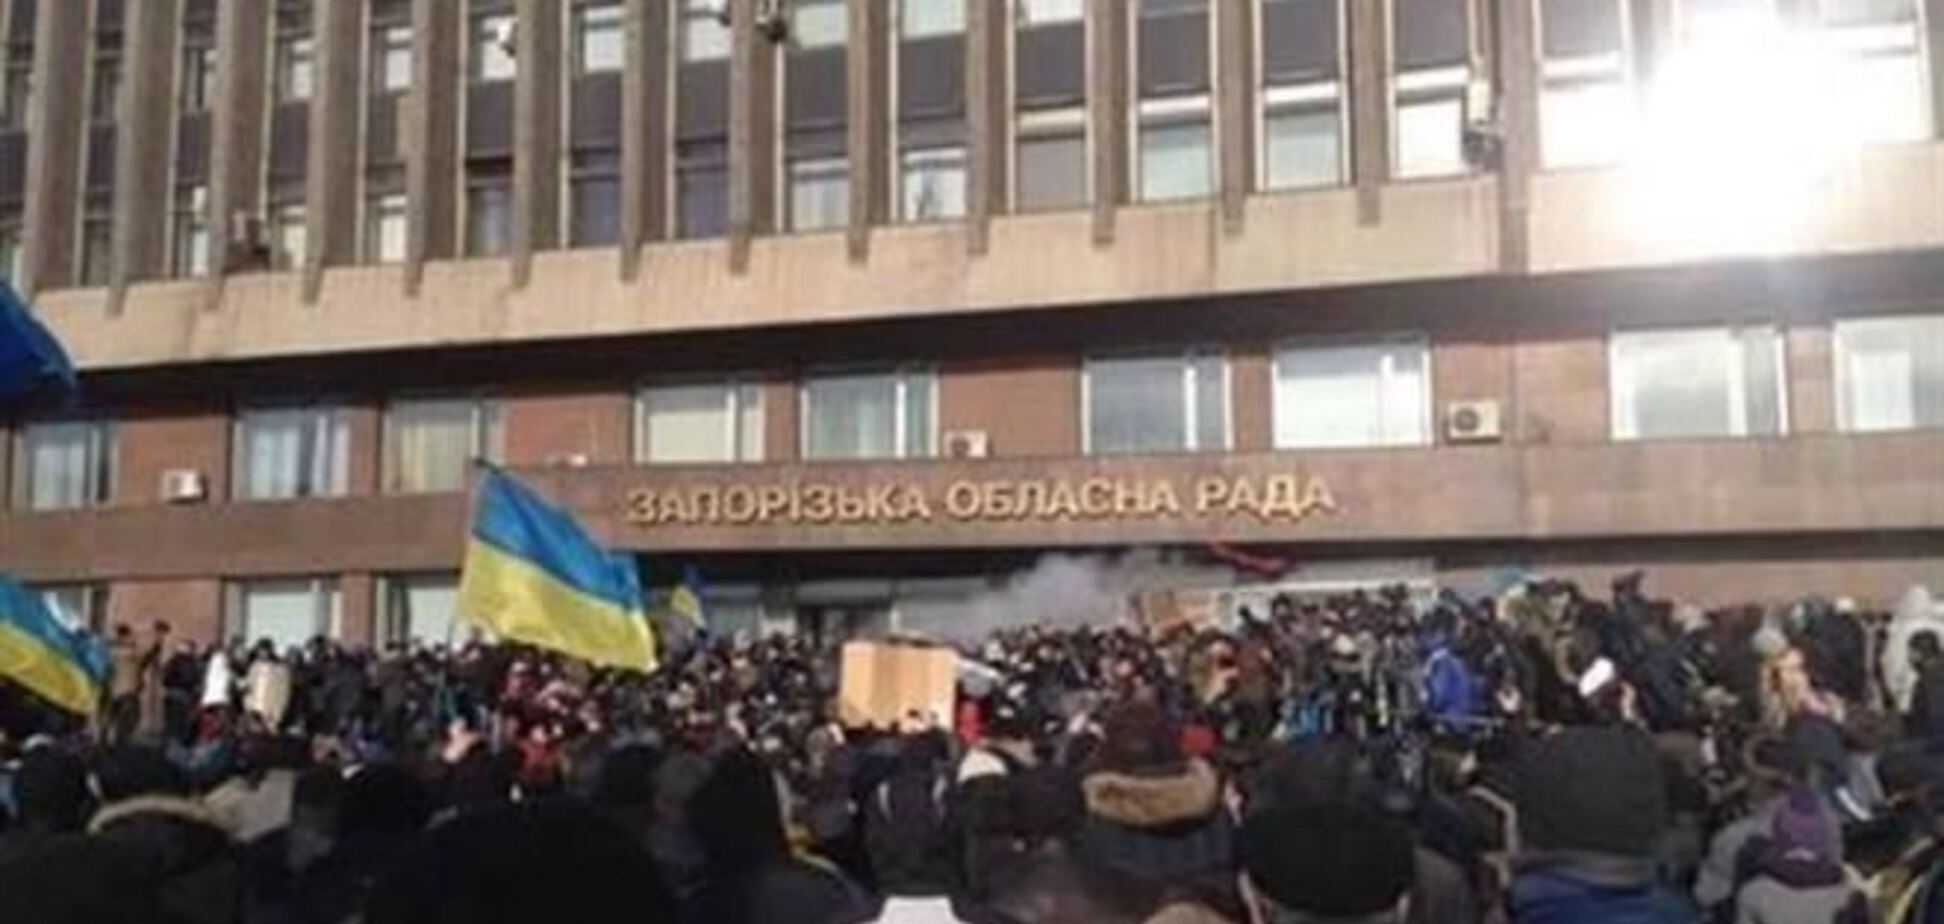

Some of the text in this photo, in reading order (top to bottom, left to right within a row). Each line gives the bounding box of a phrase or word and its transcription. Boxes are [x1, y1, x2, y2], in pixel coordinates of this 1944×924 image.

[626, 474, 1336, 524] ЗАПОРІЗЬКА ОБЛАСНА РАДА
